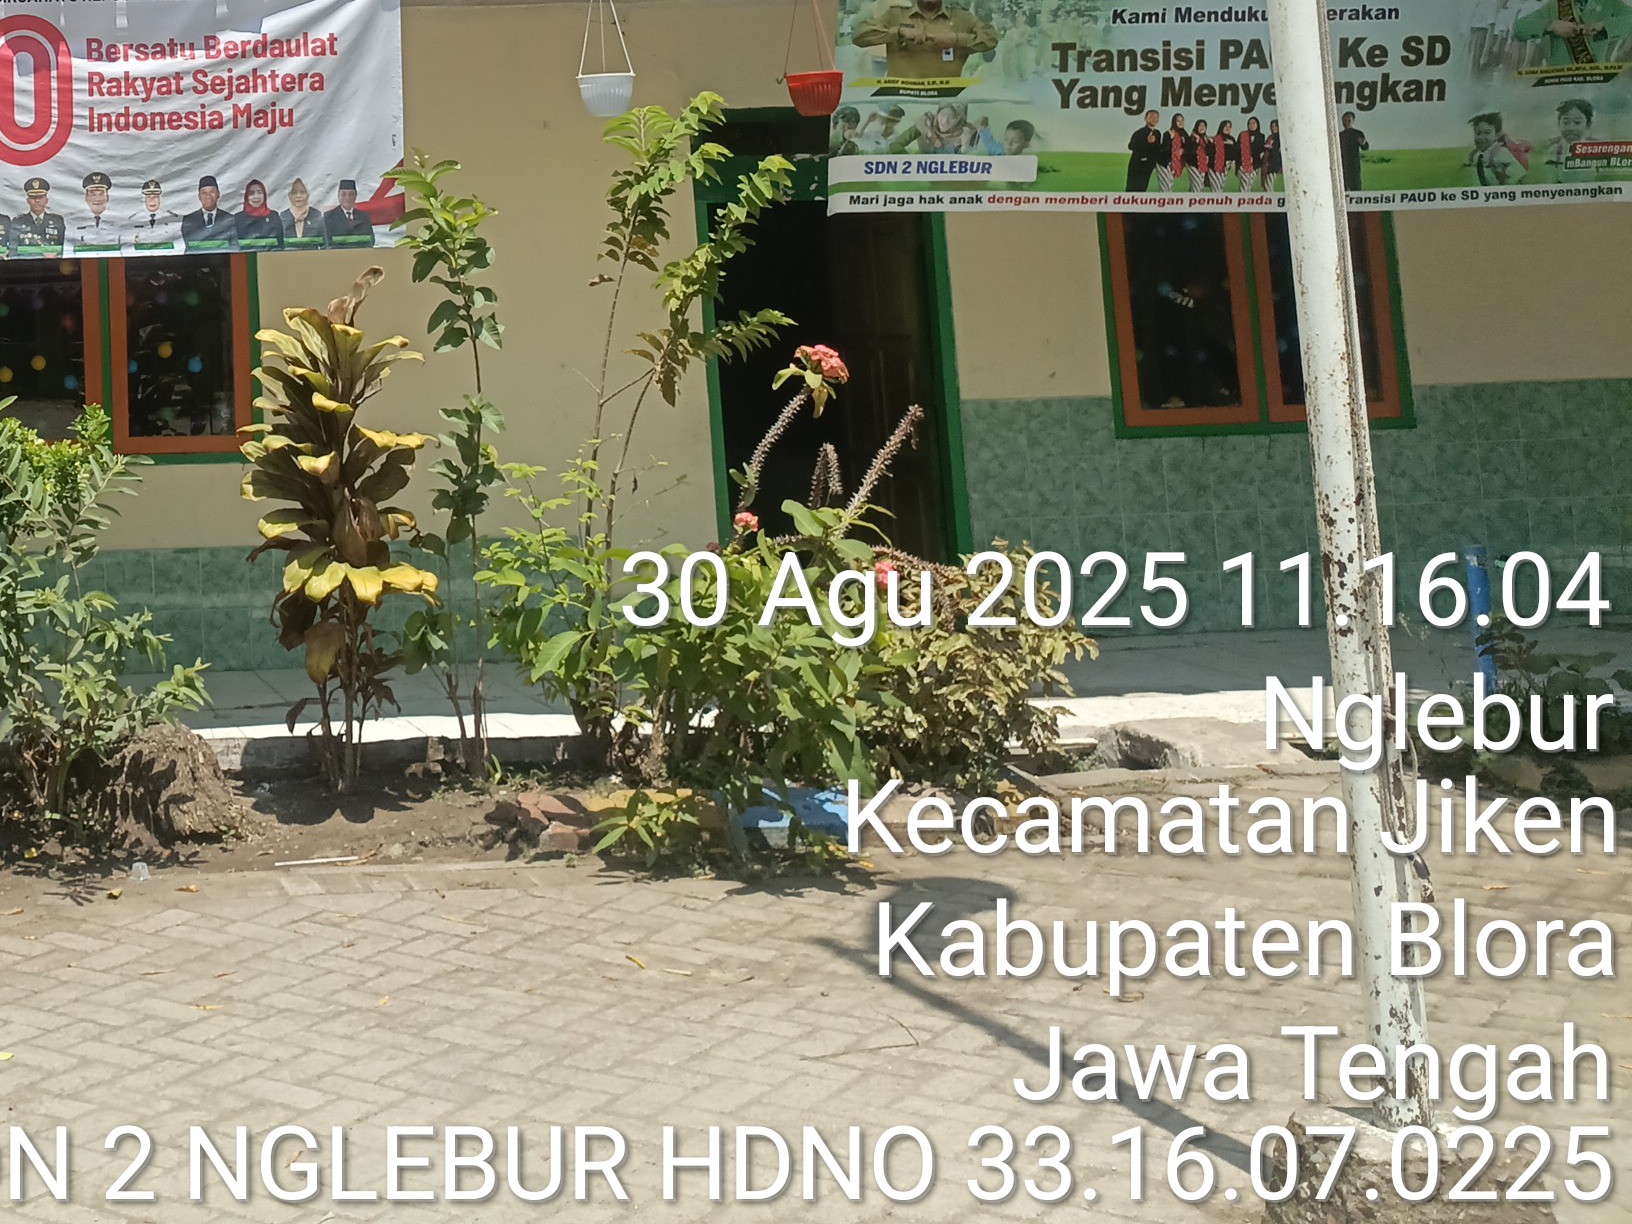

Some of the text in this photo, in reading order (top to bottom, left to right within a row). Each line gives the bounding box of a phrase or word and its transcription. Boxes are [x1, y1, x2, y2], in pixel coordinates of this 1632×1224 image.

[1111, 7, 1168, 25] Kami
[1325, 4, 1400, 22] erakan
[85, 32, 338, 64] Bersatu Berdaulat
[1051, 40, 1205, 73] Transisi
[1338, 37, 1389, 68] Ke
[1401, 35, 1451, 68] SD
[87, 68, 325, 103] Rakyat Sejahtera
[1051, 78, 1147, 117] Yang
[88, 101, 295, 134] Indonesia Maju
[864, 160, 993, 175] SDN 2 NGLEBUR
[1610, 156, 1632, 167] BLor
[849, 195, 879, 205] Mari
[883, 194, 915, 207] jaga
[918, 194, 945, 205] hak
[948, 194, 984, 205] anak
[987, 194, 1040, 207] dengan
[1045, 195, 1109, 206] memberi
[1113, 195, 1184, 207] dukungan
[1188, 195, 1233, 207] penuh
[1237, 195, 1273, 207] pada
[1400, 192, 1437, 203] PAUD
[1440, 191, 1457, 202] ke
[1461, 190, 1479, 201] SD
[1483, 190, 1517, 203] yang
[1520, 185, 1623, 200] menyenangkan
